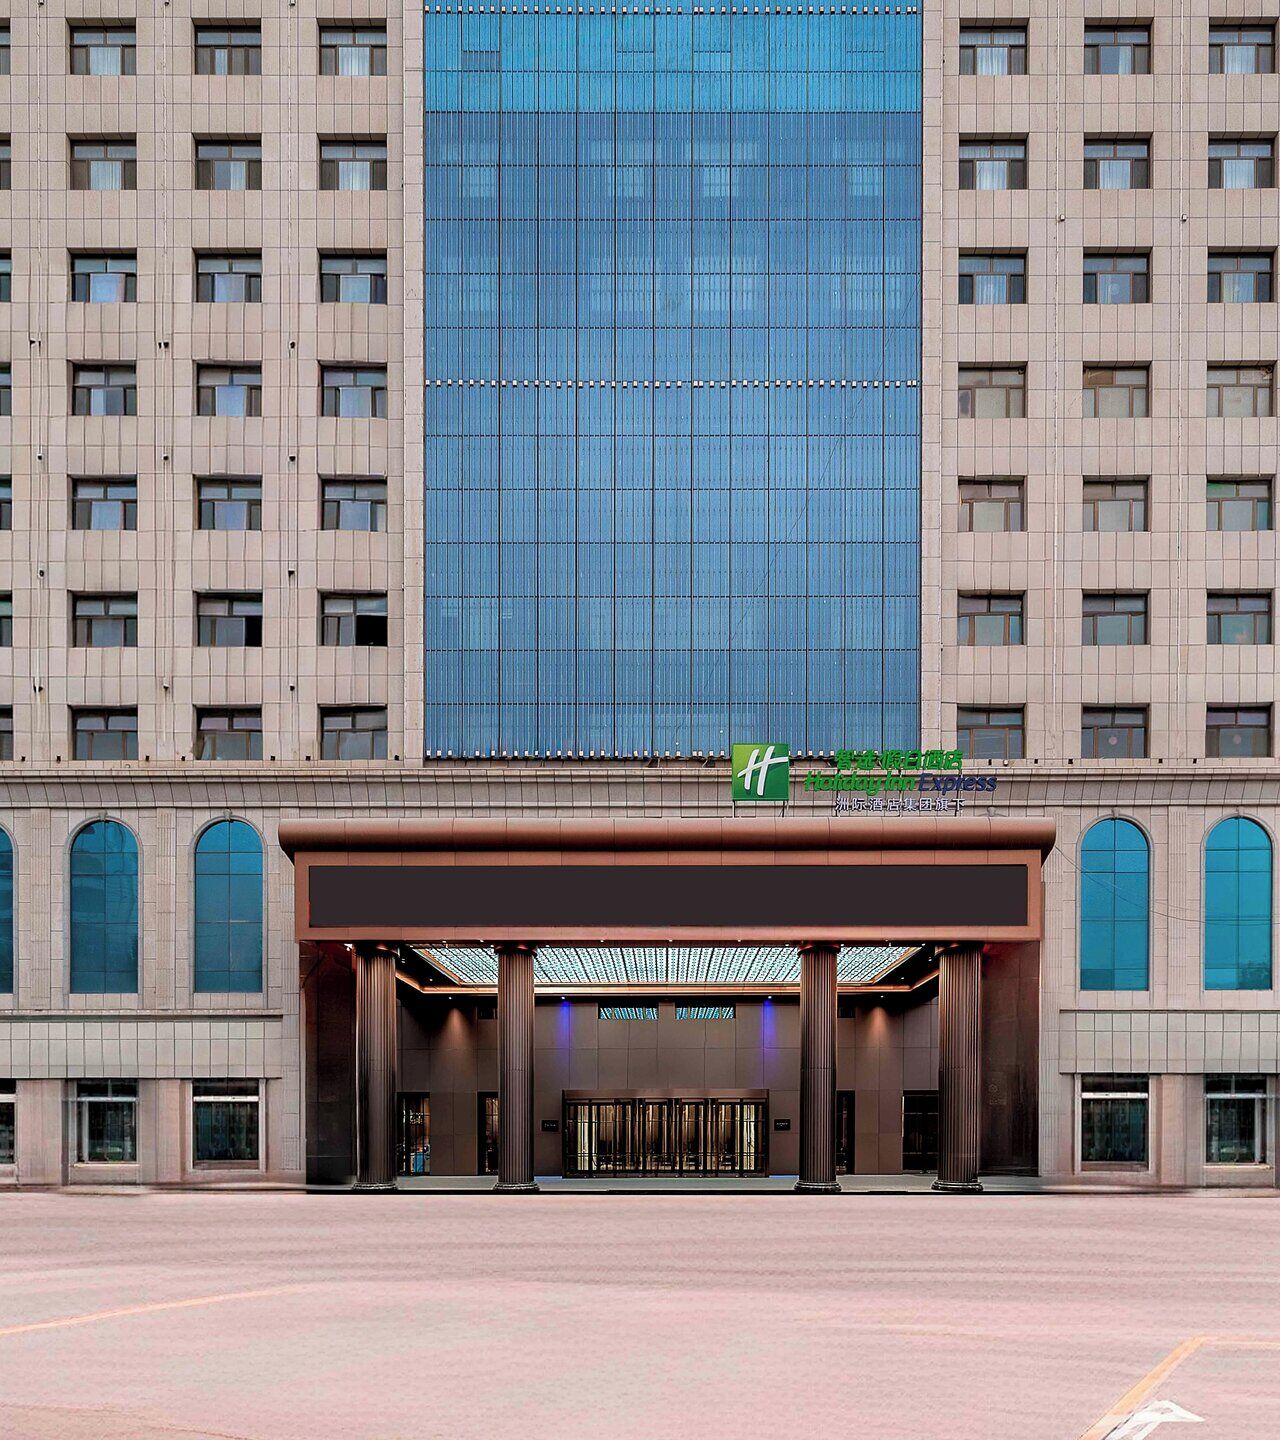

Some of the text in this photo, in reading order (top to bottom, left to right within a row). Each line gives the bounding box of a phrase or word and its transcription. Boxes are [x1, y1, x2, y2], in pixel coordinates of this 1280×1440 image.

[835, 748, 964, 771] 智选假日酒店
[803, 770, 998, 796] Holiday Inn Express
[835, 796, 966, 812] 洲际酒店集团旗下
